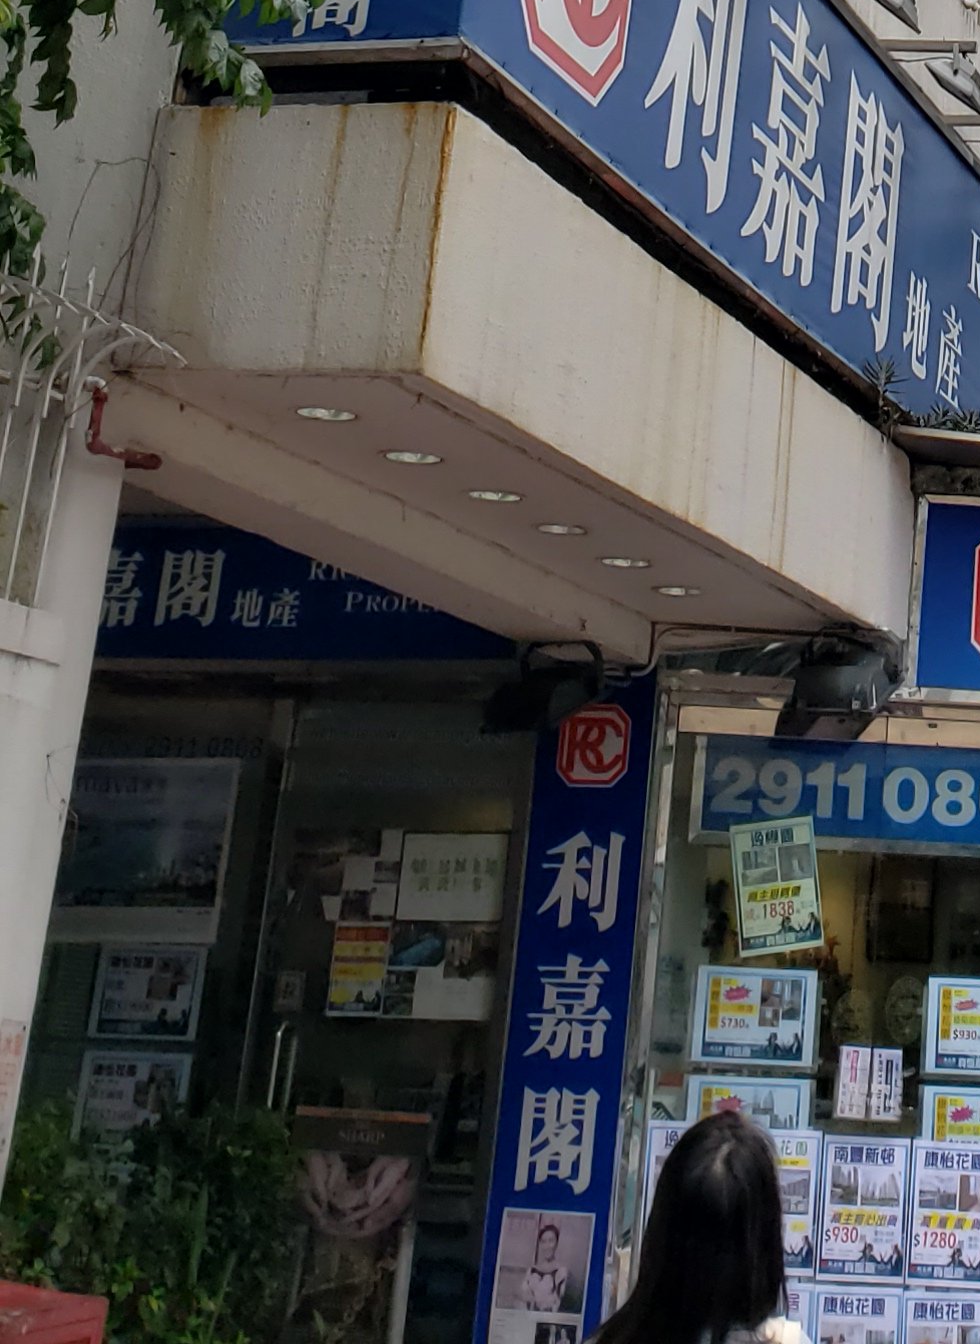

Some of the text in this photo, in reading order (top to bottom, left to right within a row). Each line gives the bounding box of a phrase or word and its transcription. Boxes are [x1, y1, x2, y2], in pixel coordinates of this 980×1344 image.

[902, 270, 964, 410] 地產
[229, 586, 302, 629] 地產
[710, 756, 867, 821] 2911
[513, 830, 627, 1196] 利嘉閣
[952, 1029, 977, 1041] $930
[825, 1226, 859, 1244] $930
[914, 1231, 958, 1250] $1280
